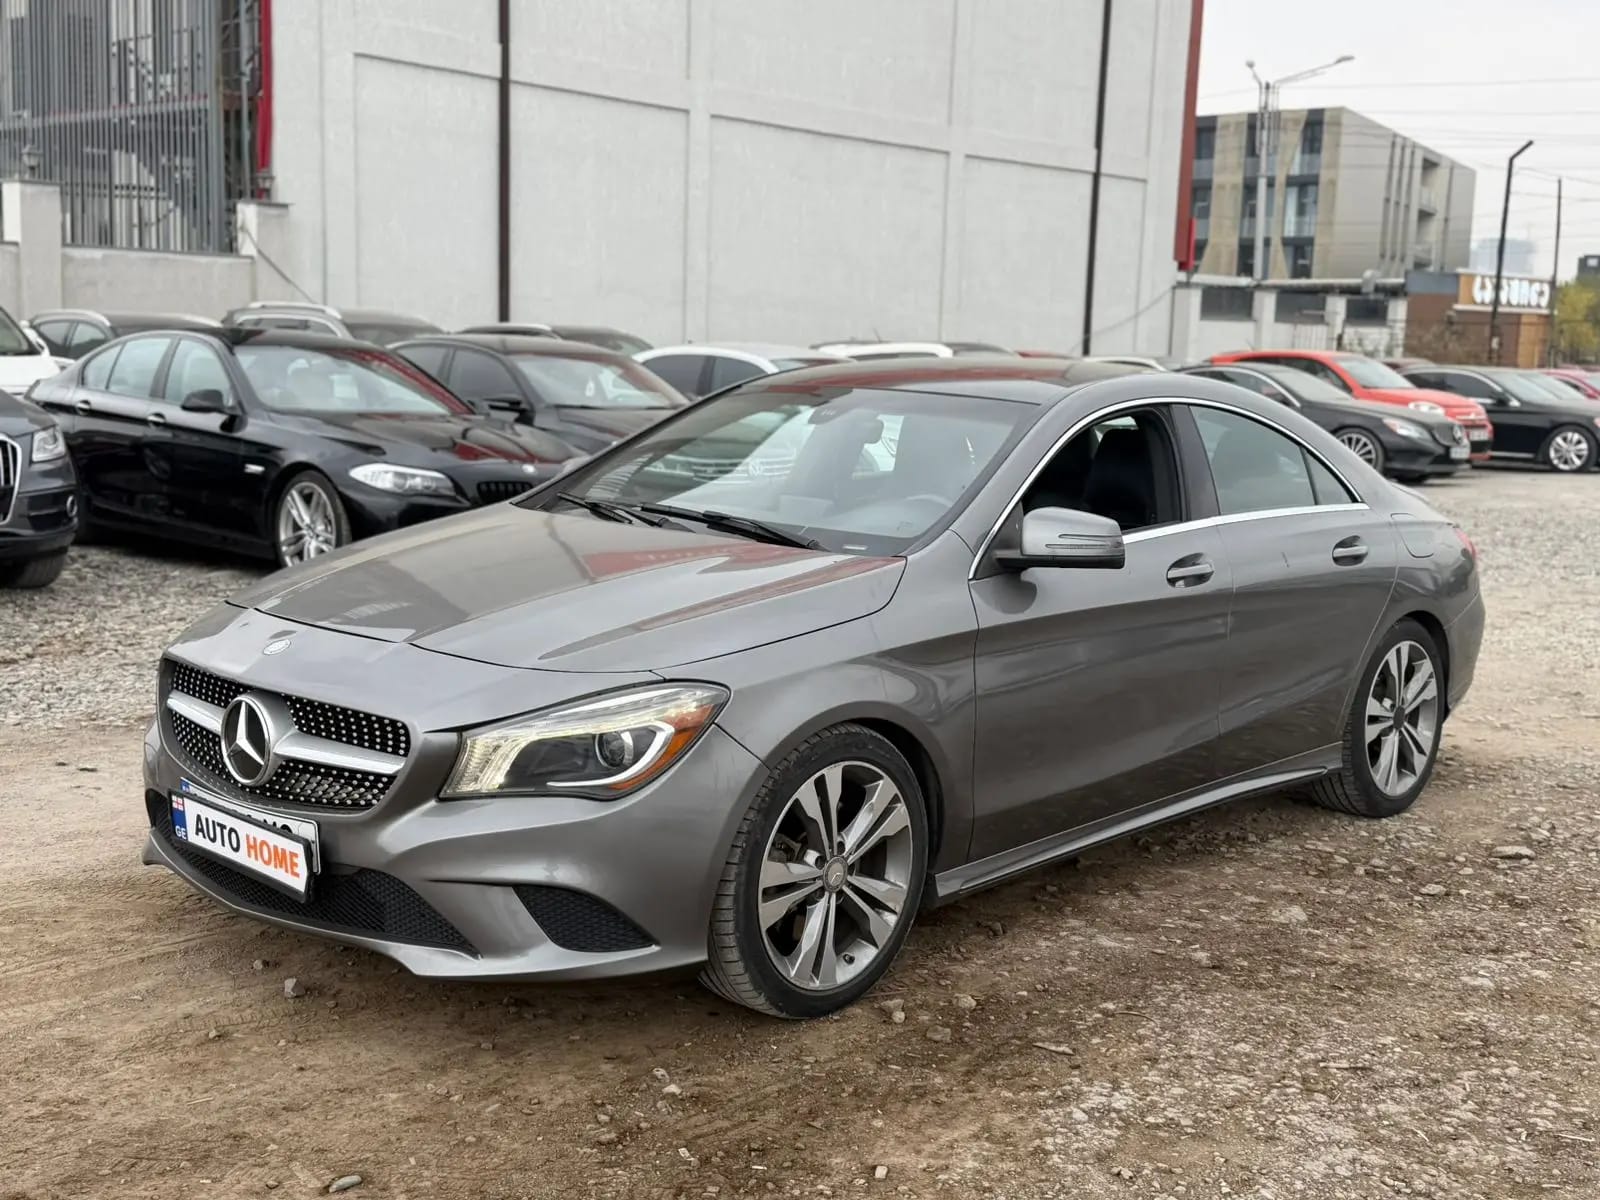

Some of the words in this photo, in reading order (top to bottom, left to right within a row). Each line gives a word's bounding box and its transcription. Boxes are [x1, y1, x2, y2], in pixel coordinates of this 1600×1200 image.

[175, 825, 187, 840] GE
[195, 814, 240, 853] AUTO
[246, 834, 300, 878] HOME
